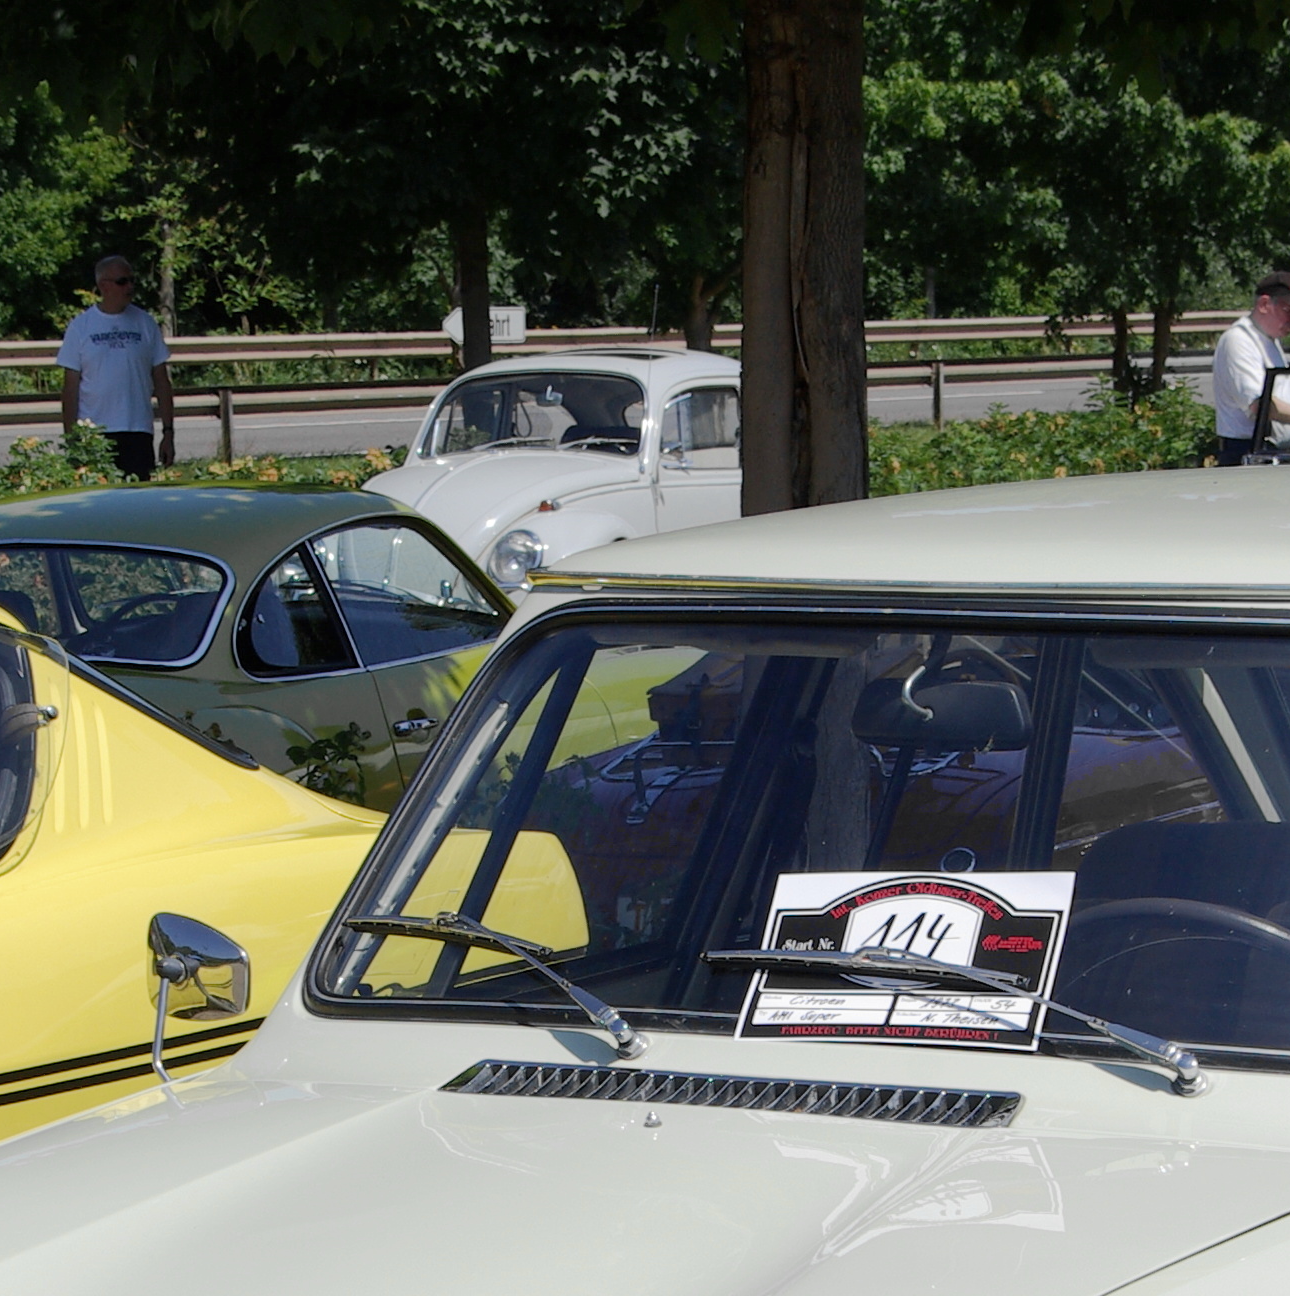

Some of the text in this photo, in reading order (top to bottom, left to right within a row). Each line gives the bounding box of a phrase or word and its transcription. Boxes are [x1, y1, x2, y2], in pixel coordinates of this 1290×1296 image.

[489, 313, 511, 337] ahrt
[861, 911, 961, 958] 114
[781, 937, 836, 952] Start Nr.
[990, 999, 1017, 1010] 54
[800, 1010, 843, 1023] Super
[845, 1026, 880, 1036] BITTE
[883, 1026, 922, 1037] NICHT
